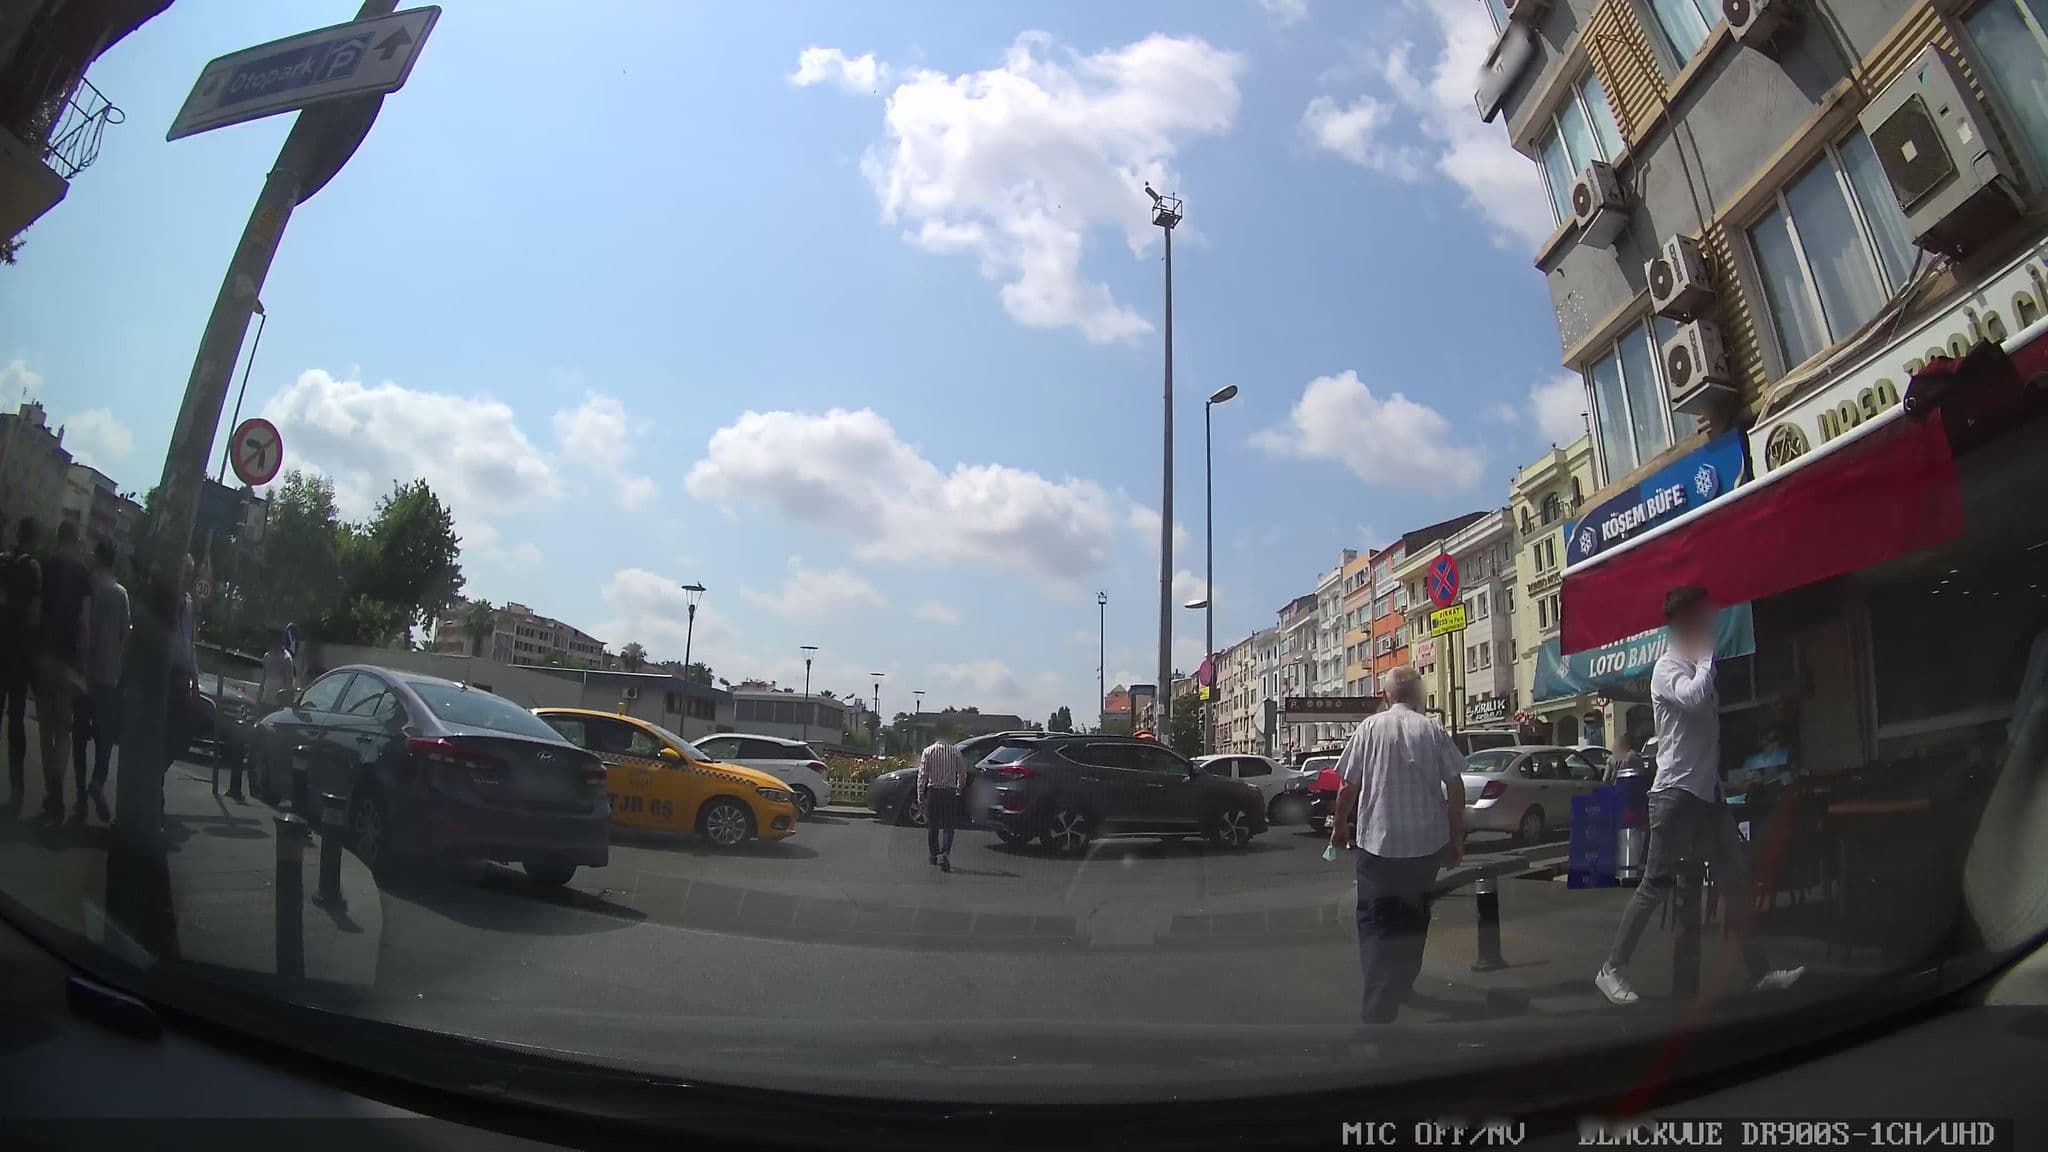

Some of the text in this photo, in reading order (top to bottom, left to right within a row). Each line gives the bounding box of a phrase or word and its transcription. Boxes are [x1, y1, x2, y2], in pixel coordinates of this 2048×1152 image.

[231, 56, 313, 94] Otopark
[1602, 484, 1684, 541] KÖŞEM BÜFE
[1589, 650, 1625, 678] LOTO
